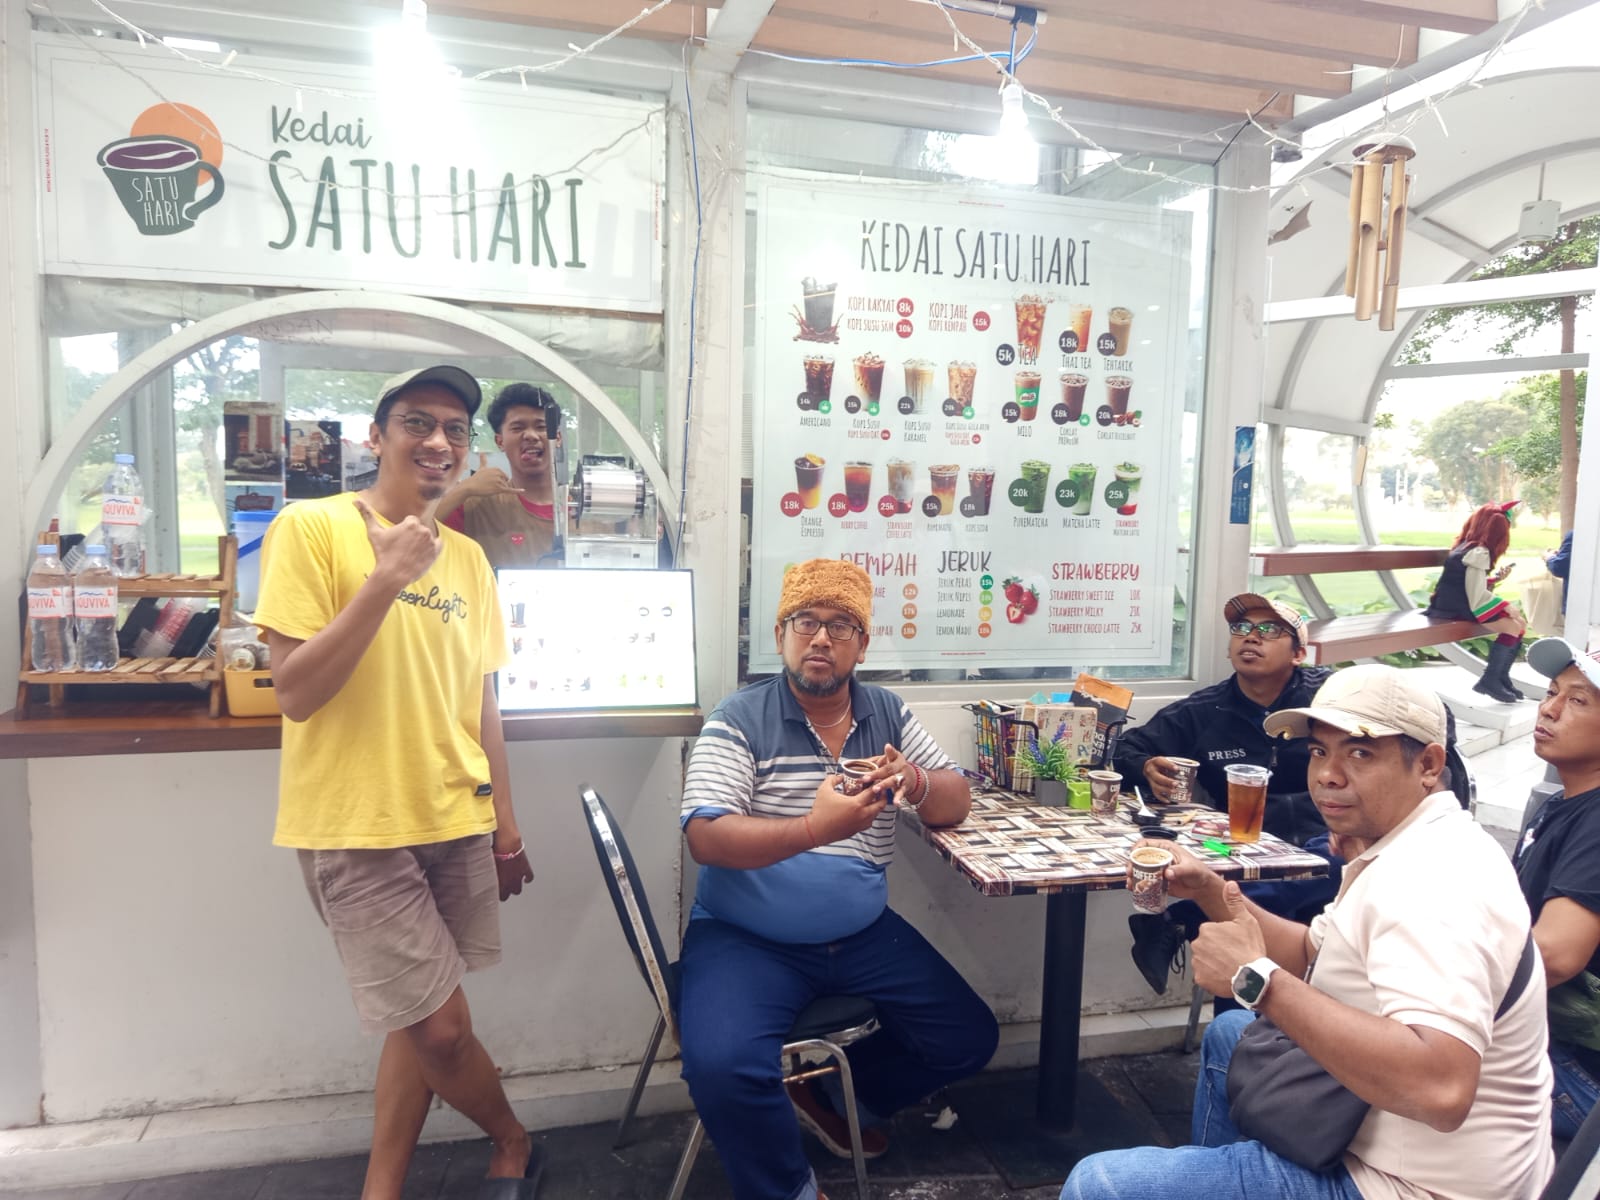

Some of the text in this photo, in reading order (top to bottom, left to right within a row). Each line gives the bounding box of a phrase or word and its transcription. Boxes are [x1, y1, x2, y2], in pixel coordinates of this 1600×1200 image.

[271, 105, 372, 149] Kedai
[131, 176, 179, 202] SATU
[143, 200, 180, 226] HARI
[268, 150, 421, 258] SATU
[450, 166, 586, 268] HARI
[861, 219, 1090, 286] KEDAI SATU HARI
[848, 296, 895, 313] KOPI RAKYAT
[899, 302, 912, 313] 8k
[928, 302, 968, 320] KOPI JAHE
[847, 318, 862, 331] KOPI
[928, 319, 943, 332] KOPI
[1061, 337, 1077, 349] 18k
[1099, 339, 1115, 350] 15k
[998, 349, 1012, 362] 5k
[1018, 343, 1037, 366] TEA
[1062, 354, 1092, 370] THAI TEA
[1013, 488, 1028, 497] 20k
[1060, 489, 1075, 498] 23k
[1108, 490, 1123, 499] 25k
[784, 501, 799, 510] 18k
[831, 502, 846, 510] 18k
[880, 503, 895, 511] 25k
[937, 550, 991, 573] JERUK
[1052, 562, 1140, 581] STRAWBERRY
[1049, 589, 1084, 601] STRAWBERRY
[1104, 590, 1114, 600] ICE
[1048, 605, 1104, 617] STRAWBERRY MILKY
[1047, 622, 1082, 634] STRAWBERRY
[1103, 623, 1120, 634] LATTE
[1208, 747, 1247, 761] PRESS
